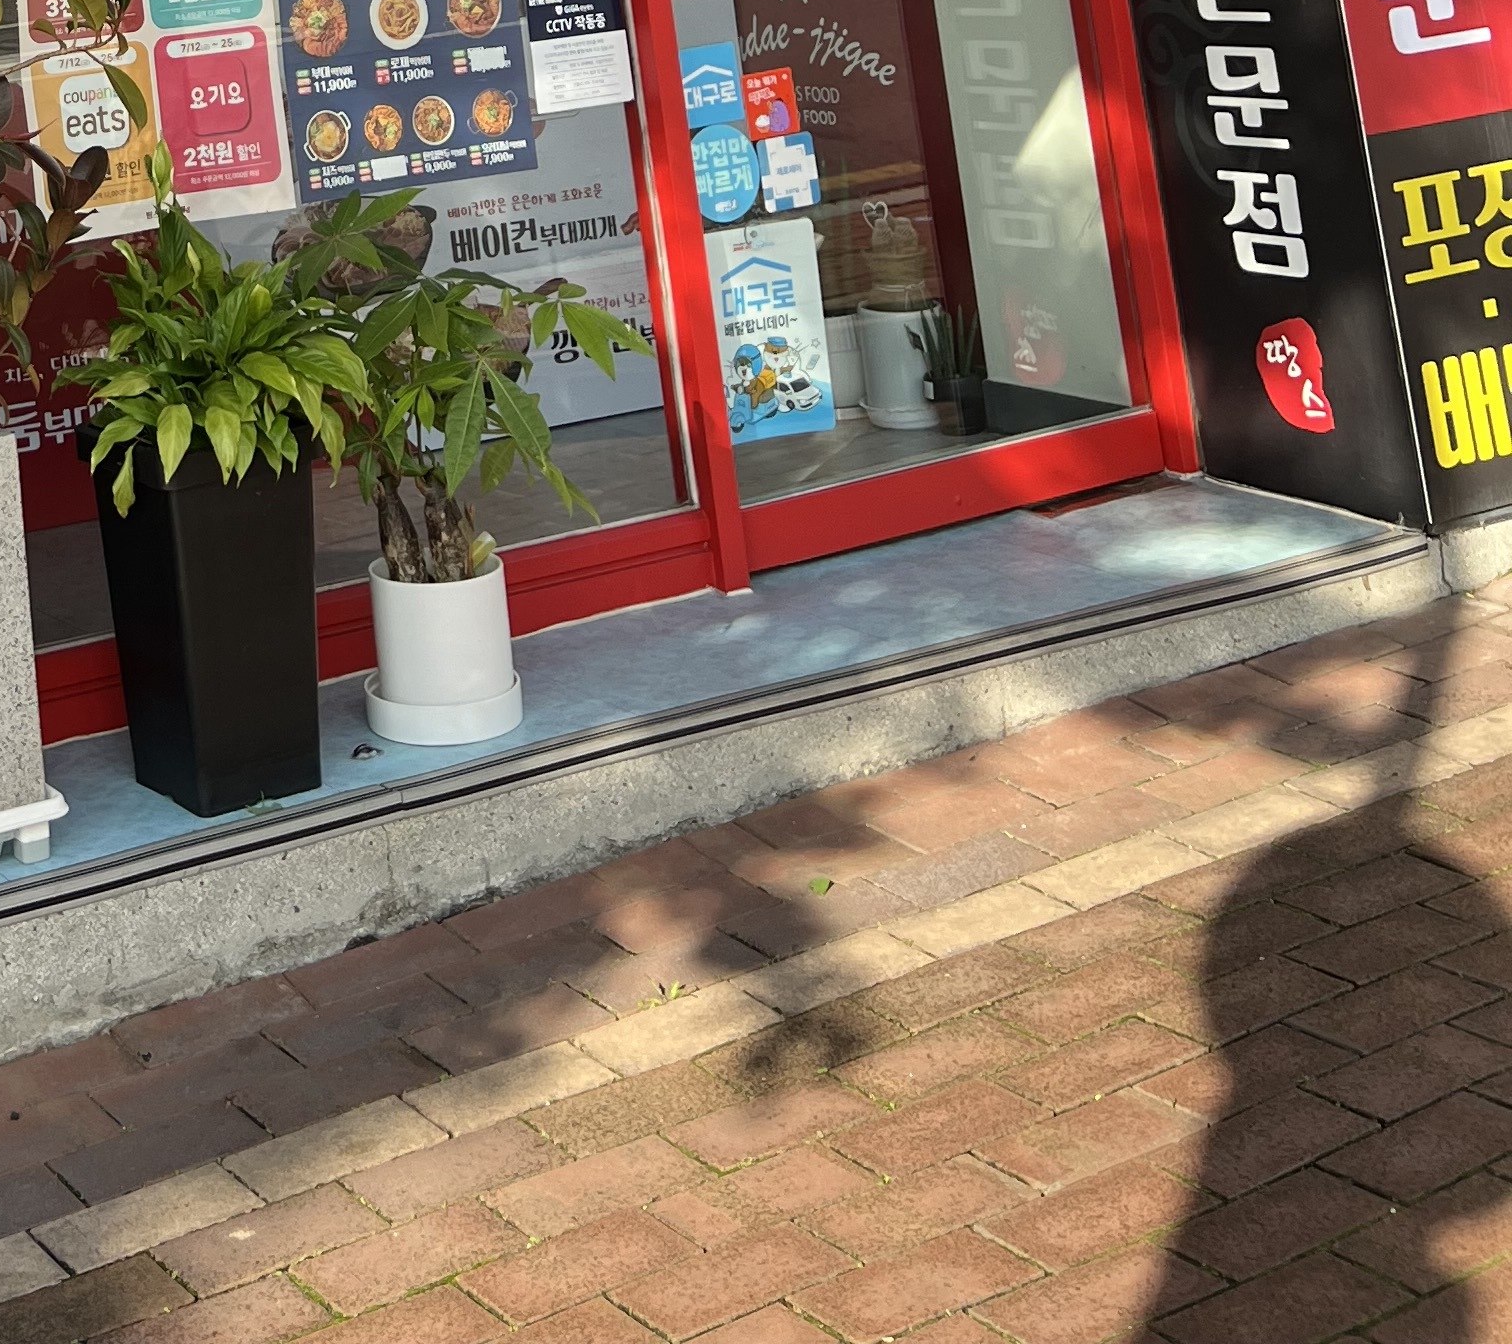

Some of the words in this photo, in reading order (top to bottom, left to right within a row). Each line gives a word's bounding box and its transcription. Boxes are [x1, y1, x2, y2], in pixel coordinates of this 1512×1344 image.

[545, 17, 573, 34] CCTV
[574, 12, 607, 31] 작동중
[189, 81, 245, 110] 요기요
[683, 79, 738, 110] 대구로
[804, 86, 841, 104] FOOD
[65, 105, 127, 138] eats
[803, 109, 838, 127] FOOD
[182, 140, 234, 168] 2천원
[236, 141, 262, 161] 할인
[114, 158, 142, 179] 할인
[721, 278, 797, 319] 대구로
